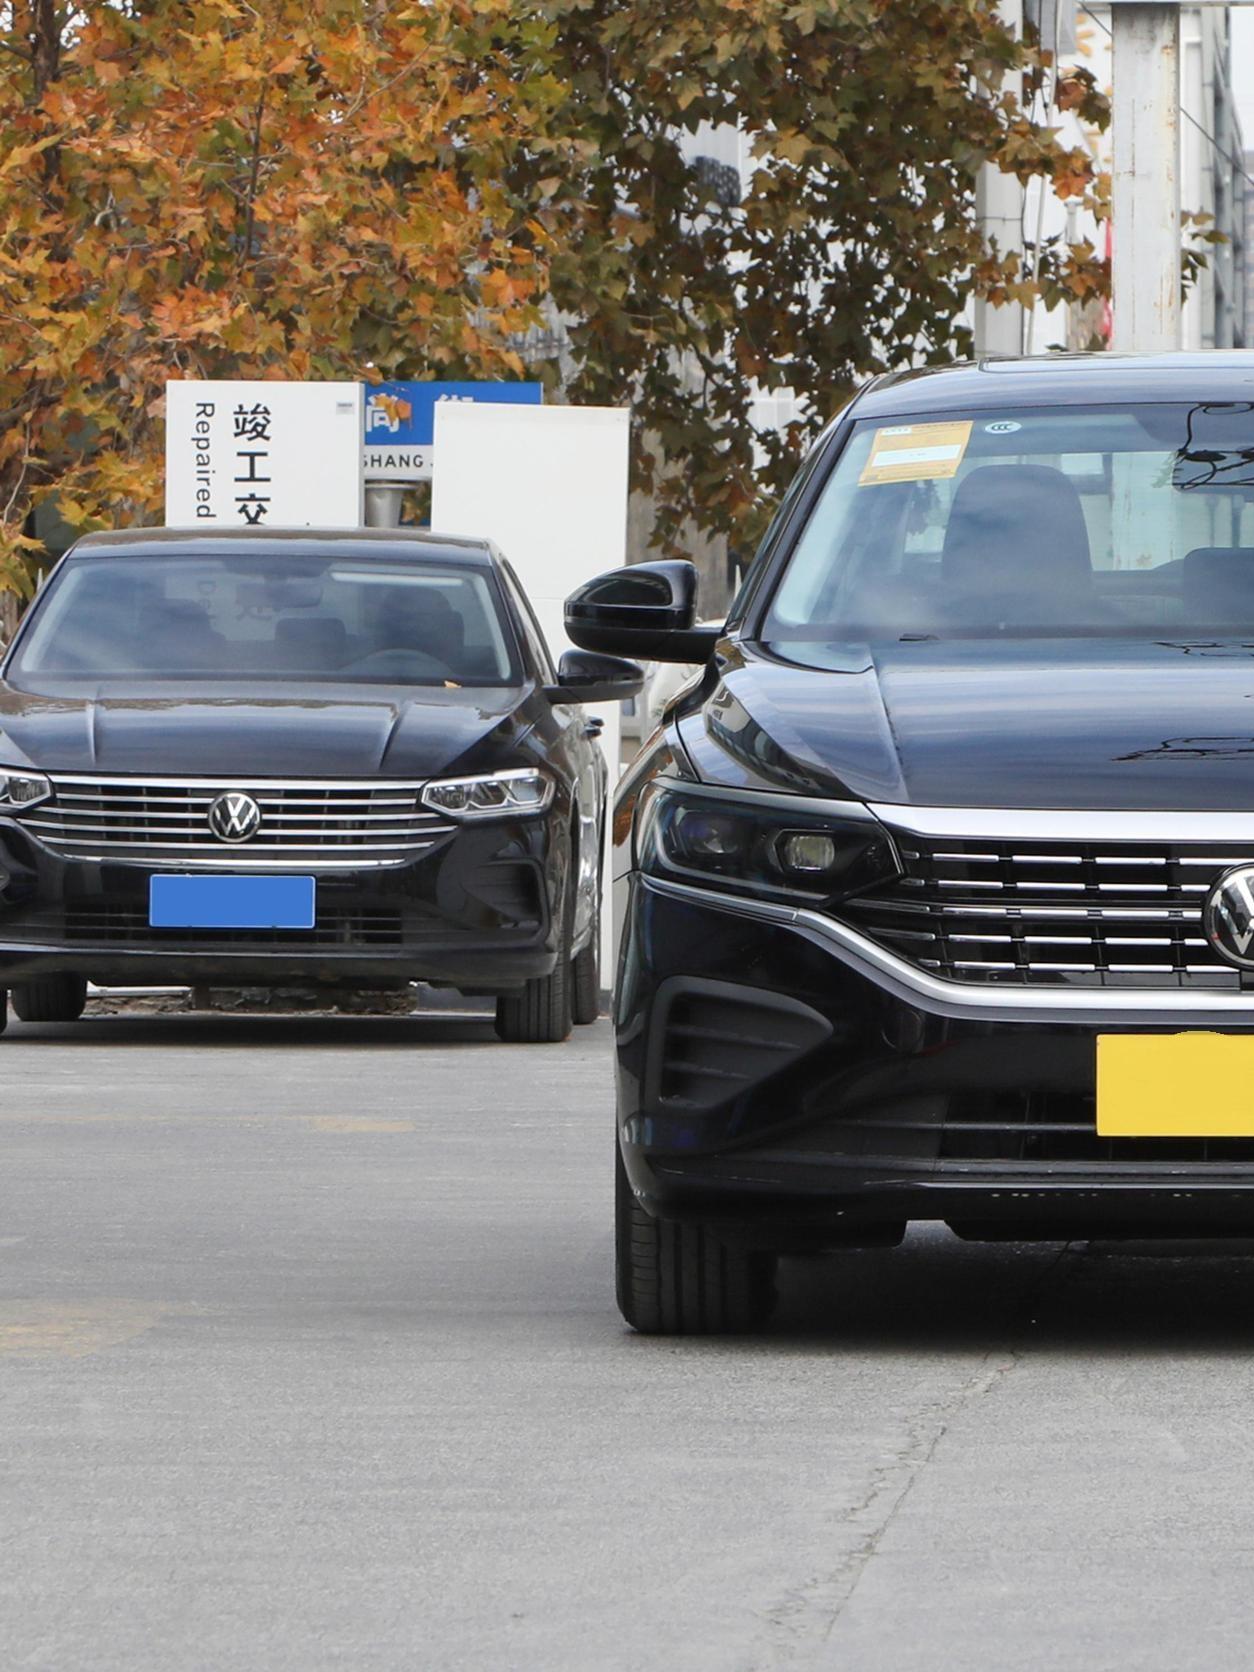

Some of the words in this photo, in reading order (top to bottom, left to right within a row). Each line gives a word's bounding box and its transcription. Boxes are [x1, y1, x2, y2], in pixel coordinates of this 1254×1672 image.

[191, 403, 217, 518] Repaired
[233, 402, 272, 525] 竣工交
